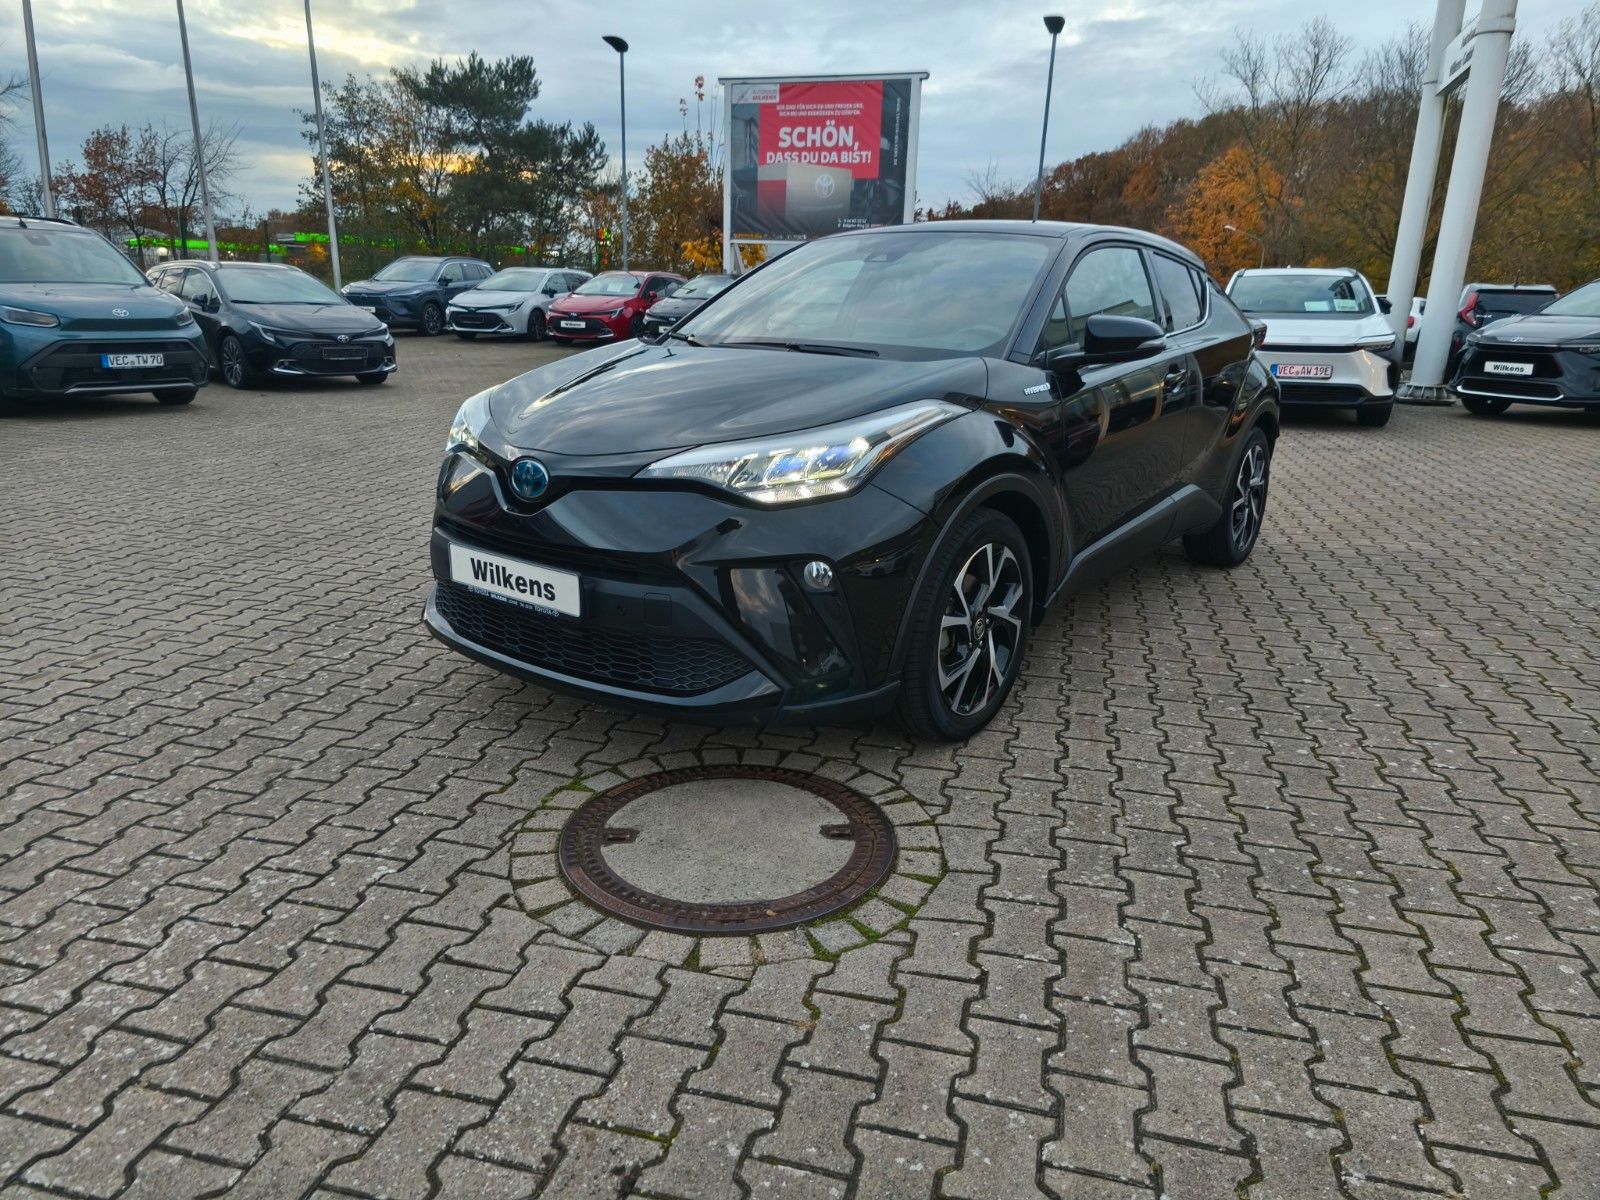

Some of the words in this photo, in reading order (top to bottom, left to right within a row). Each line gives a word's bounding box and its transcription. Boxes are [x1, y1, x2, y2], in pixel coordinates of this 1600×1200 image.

[778, 119, 859, 151] SCHÖN,
[766, 151, 799, 164] DASS
[800, 151, 819, 164] DU
[820, 151, 839, 163] DA
[840, 150, 872, 164] BIST!
[108, 355, 129, 366] VEC
[135, 355, 148, 365] TW
[150, 355, 163, 365] 70
[1278, 365, 1295, 375] VEC
[1300, 366, 1313, 376] AW
[1313, 366, 1330, 376] 19E
[1493, 364, 1525, 373] Wilkens
[470, 557, 556, 602] Wilkens
